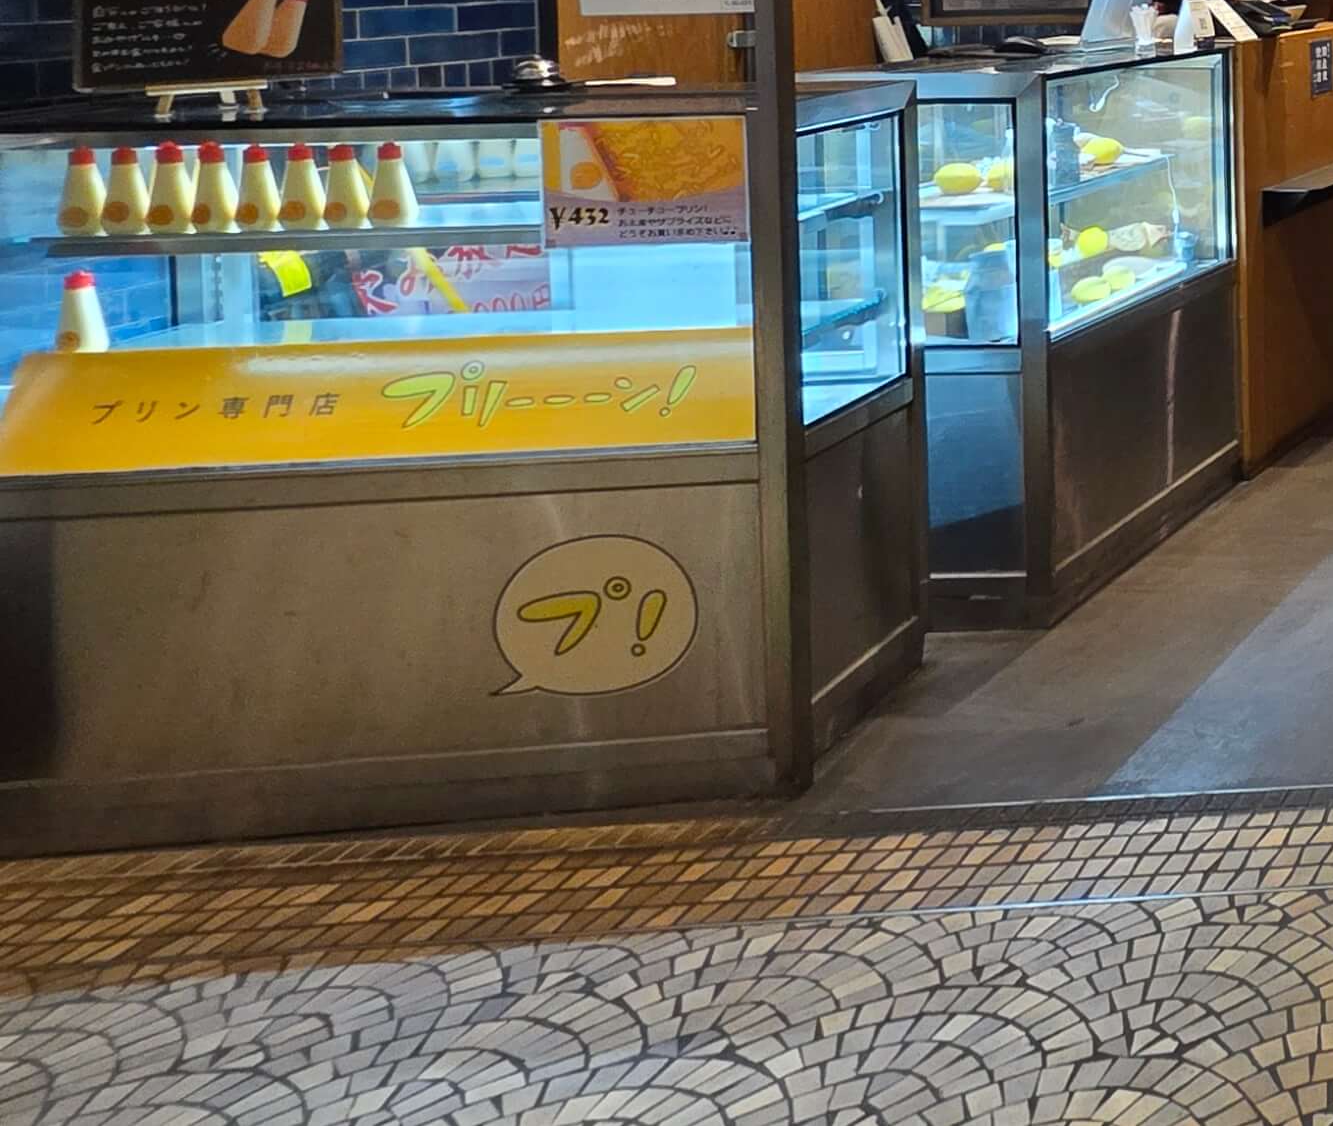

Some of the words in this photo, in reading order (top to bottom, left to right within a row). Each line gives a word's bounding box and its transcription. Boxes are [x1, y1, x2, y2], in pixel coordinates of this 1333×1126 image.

[549, 206, 610, 230] ¥432
[91, 392, 342, 426] プリン専門店
